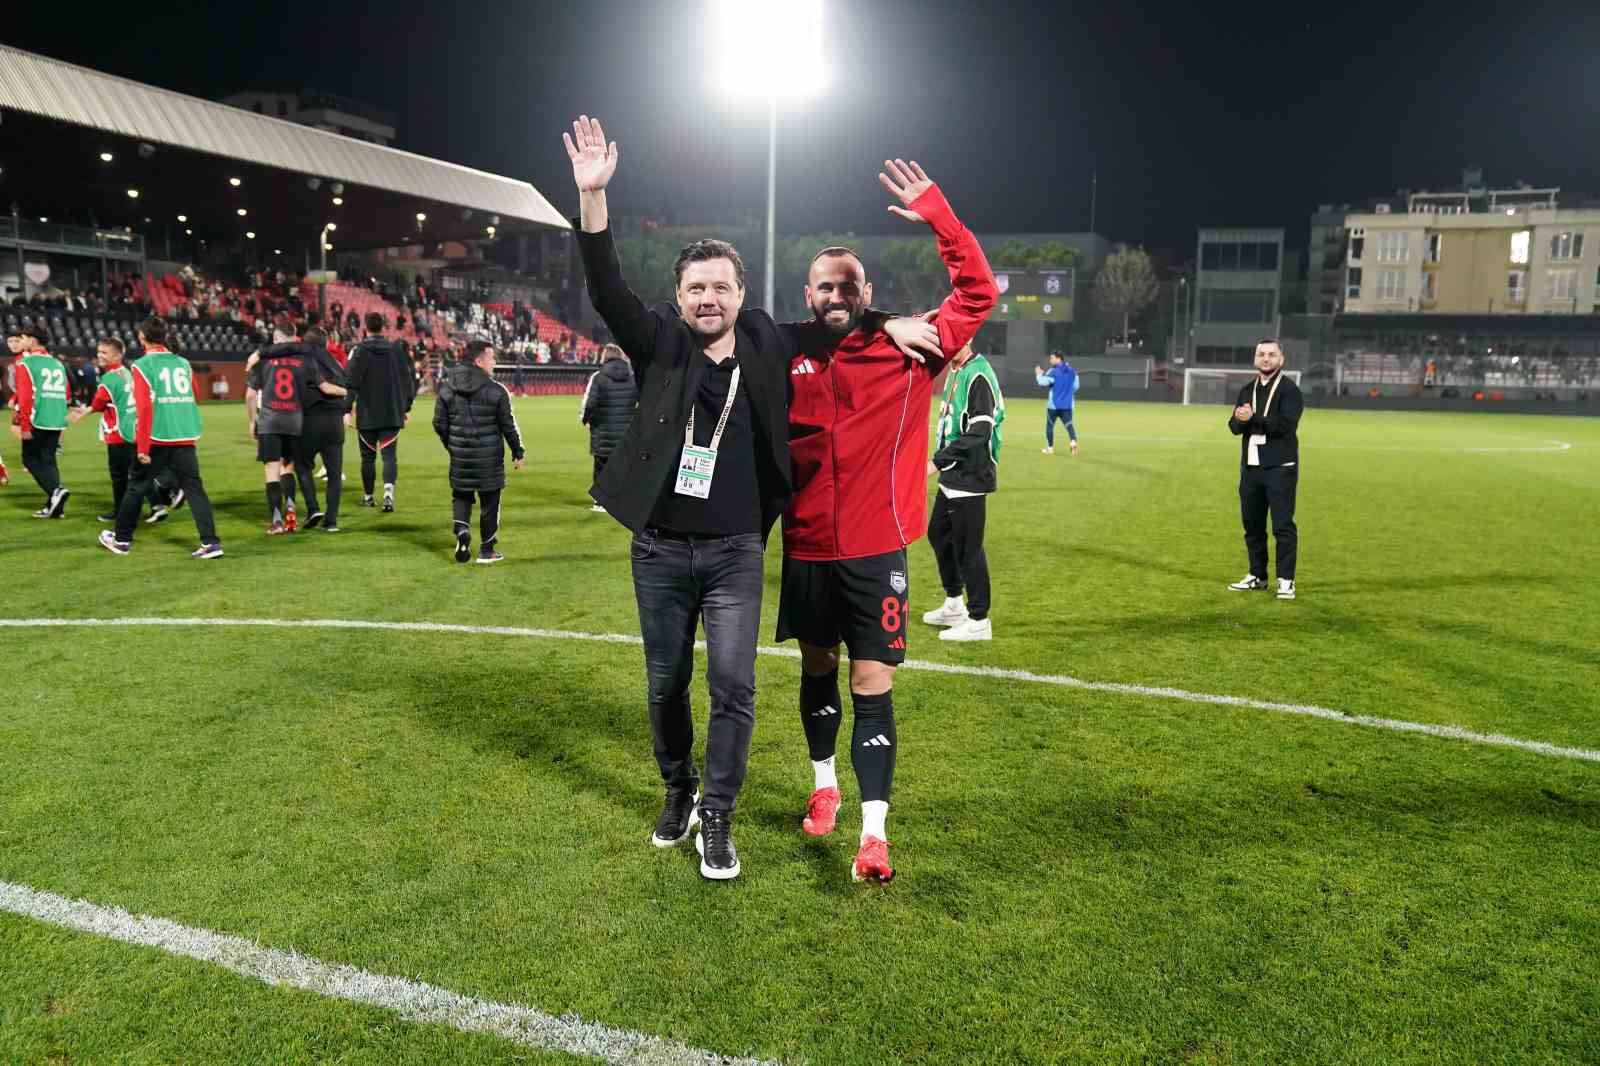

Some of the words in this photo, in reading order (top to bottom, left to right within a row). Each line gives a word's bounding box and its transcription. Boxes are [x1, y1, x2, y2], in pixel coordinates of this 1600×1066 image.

[41, 367, 65, 391] 22
[158, 367, 190, 394] 16
[274, 368, 294, 400] 8
